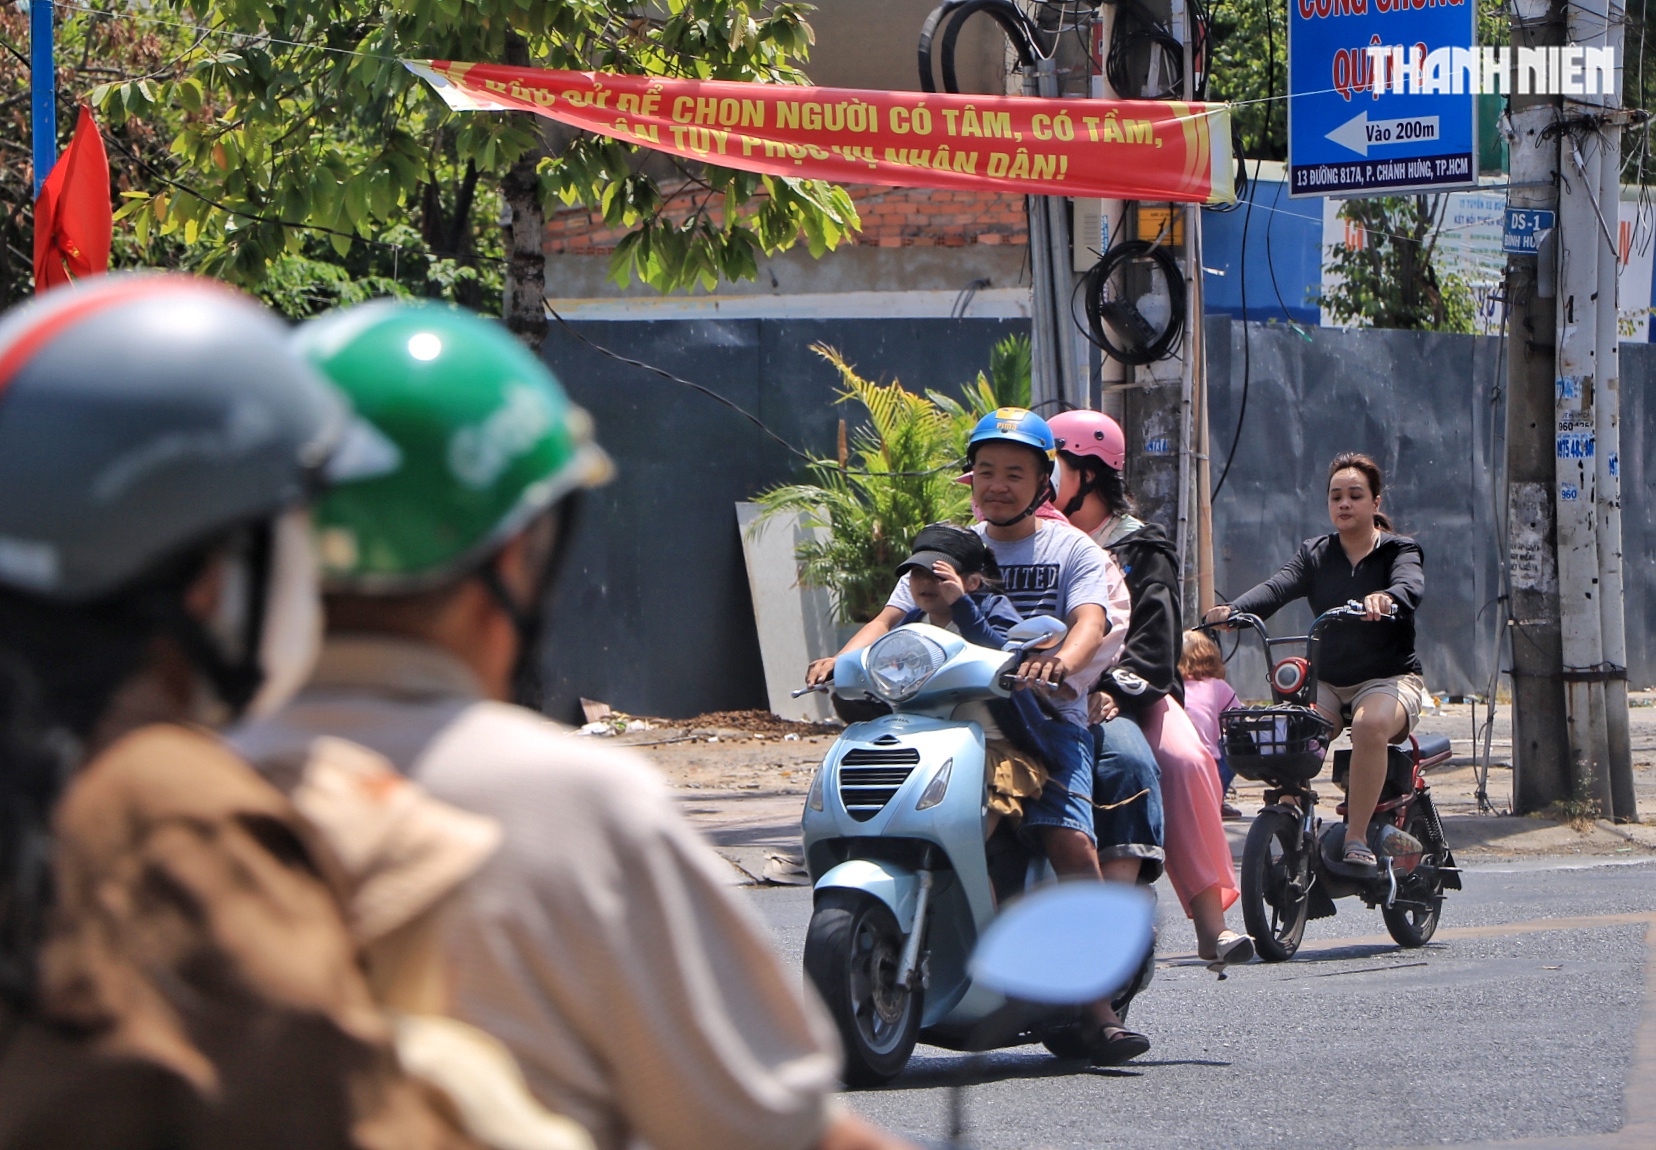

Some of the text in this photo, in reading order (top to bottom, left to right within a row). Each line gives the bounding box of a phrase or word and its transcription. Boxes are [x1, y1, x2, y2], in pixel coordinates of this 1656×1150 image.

[671, 95, 765, 131] CHỌN
[776, 97, 878, 133] NGƯỜI
[888, 102, 933, 135] CÓ
[941, 104, 1023, 142] TÂM,
[1031, 109, 1075, 141] CÓ
[1082, 108, 1163, 148] TẦM,
[1365, 121, 1434, 142] Vào 200m
[986, 147, 1068, 180] DÂN!
[1297, 157, 1468, 186] 13 ĐƯỜNG 817A, P. CHÁNH HƯNG, TP.HCM
